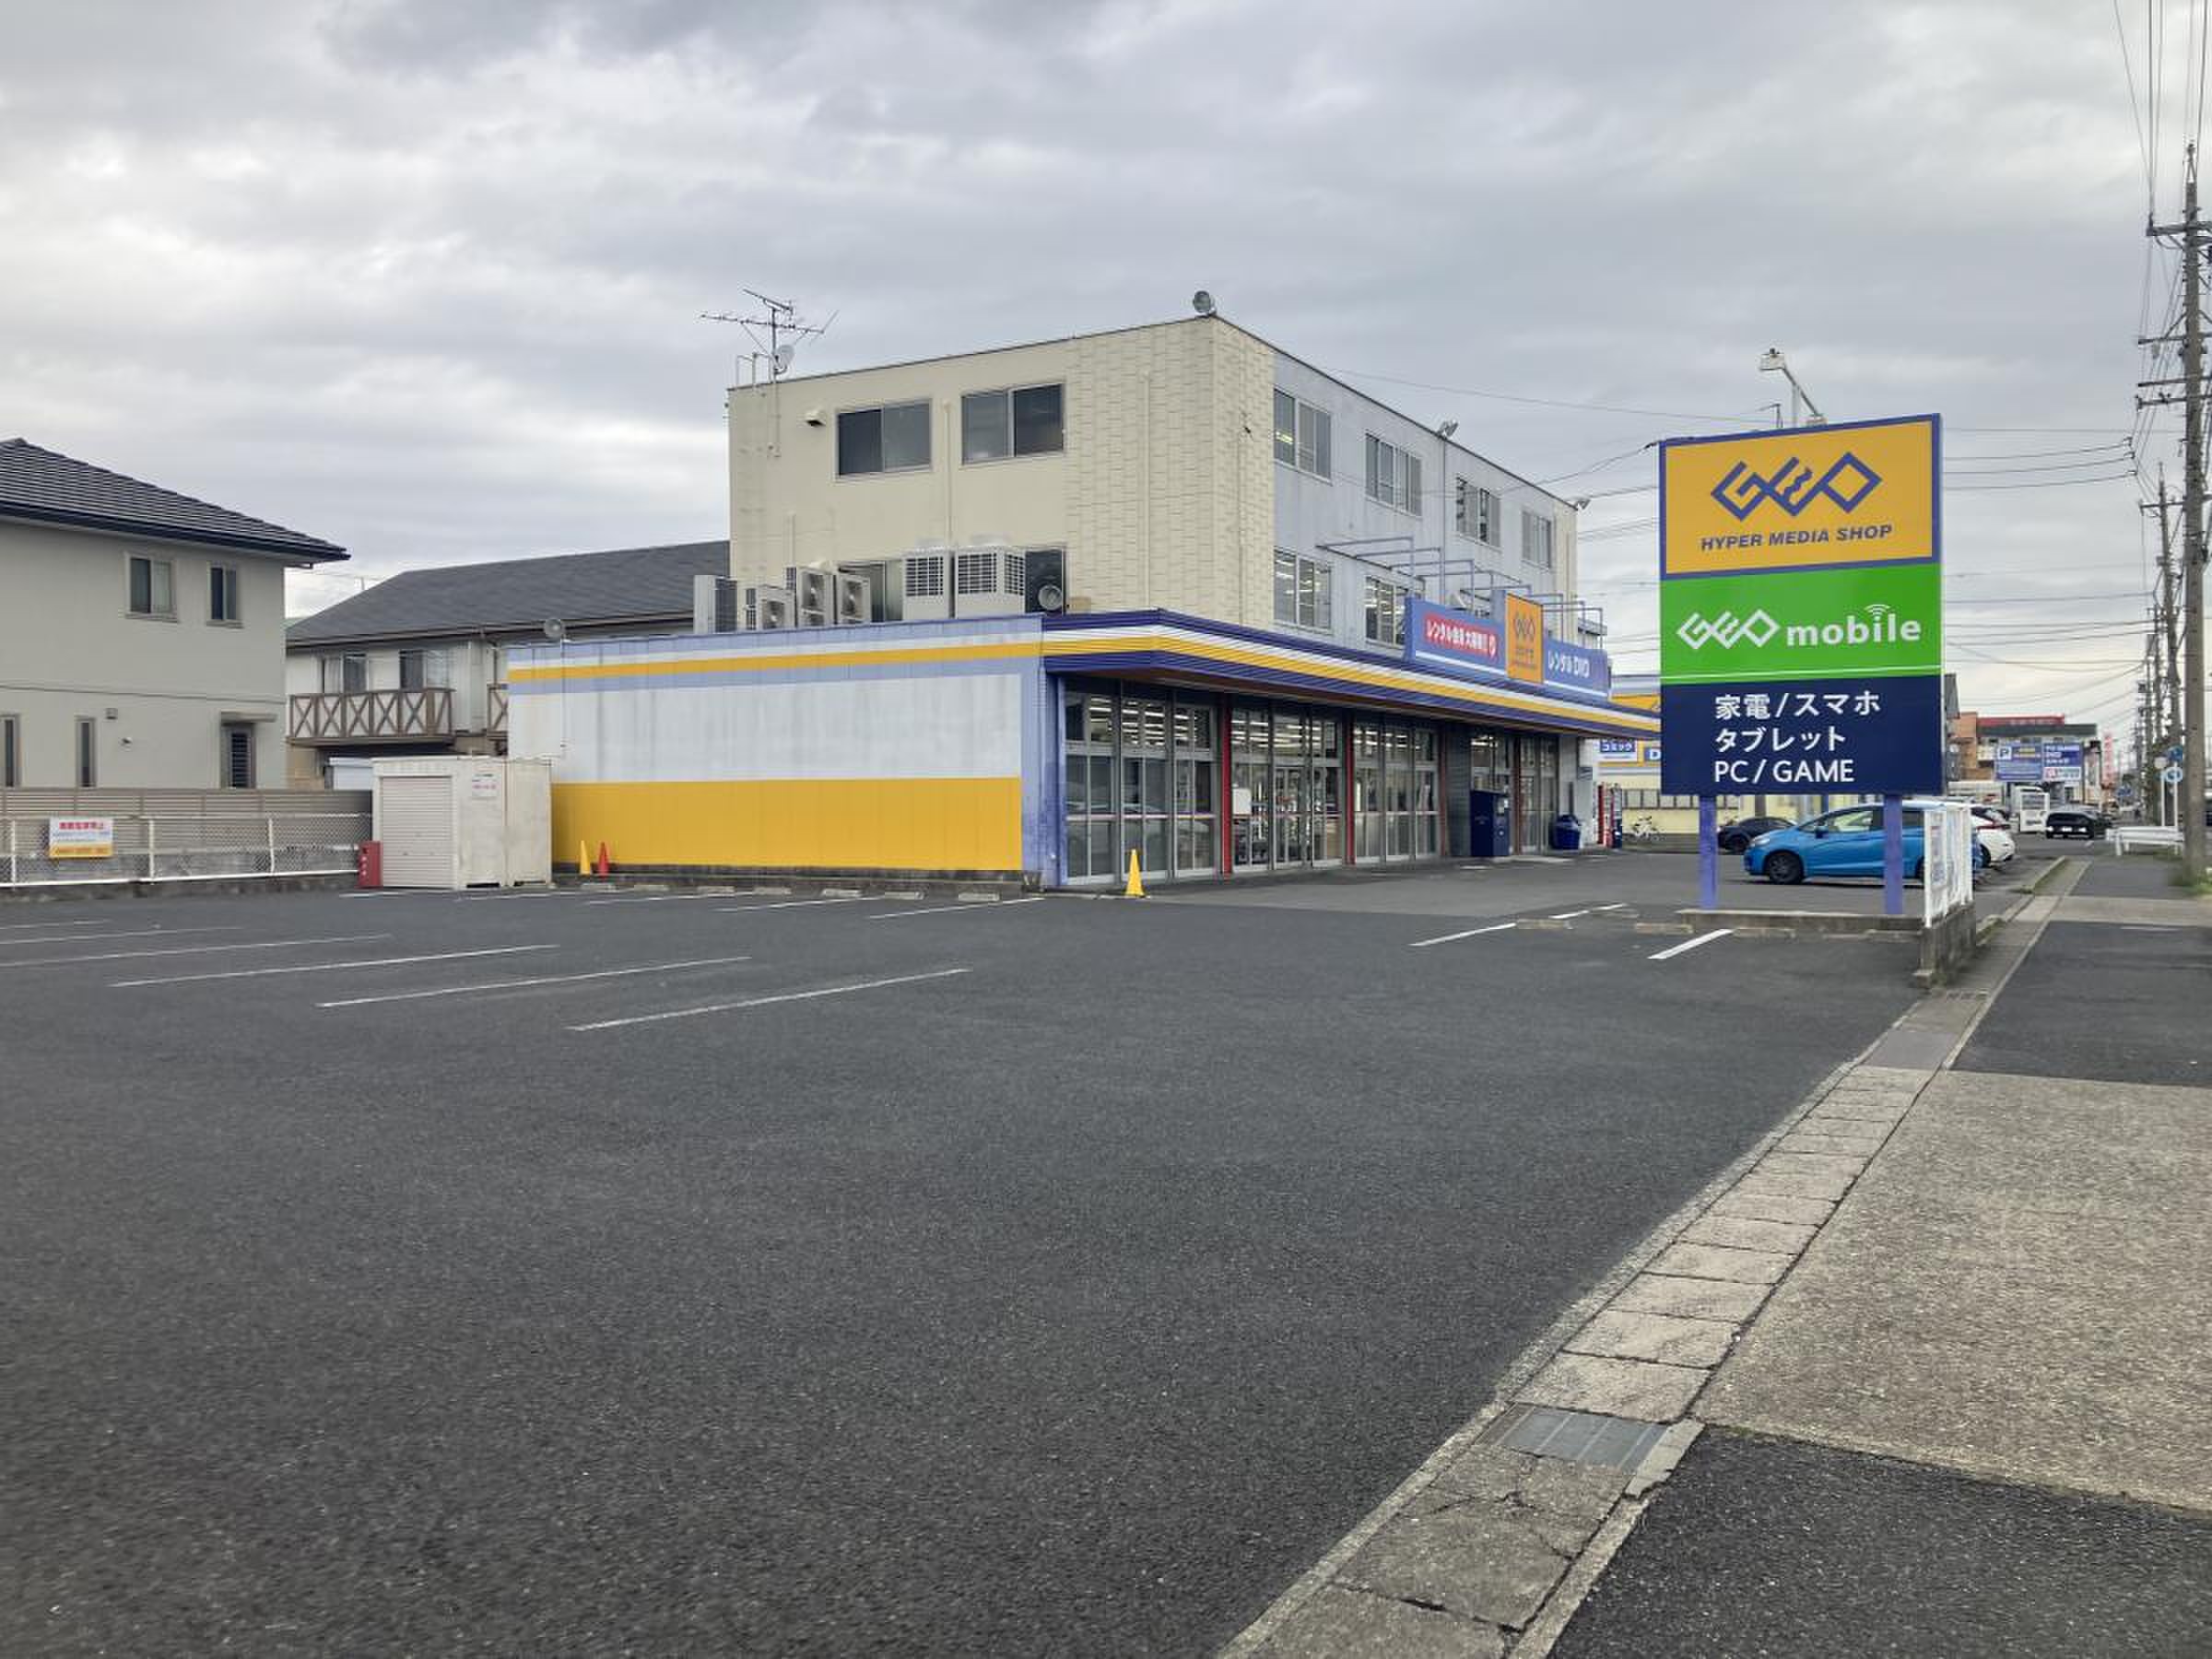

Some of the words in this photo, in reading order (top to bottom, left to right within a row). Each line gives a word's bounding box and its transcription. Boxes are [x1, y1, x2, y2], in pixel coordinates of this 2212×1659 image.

[1711, 452, 1883, 522] GEO
[1701, 534, 1762, 551] HYPER
[1769, 530, 1830, 547] MEDIA
[1837, 524, 1892, 542] SHOP
[1677, 608, 1780, 650] GEO
[1786, 609, 1921, 647] mobile
[1714, 725, 1846, 752] タブレット
